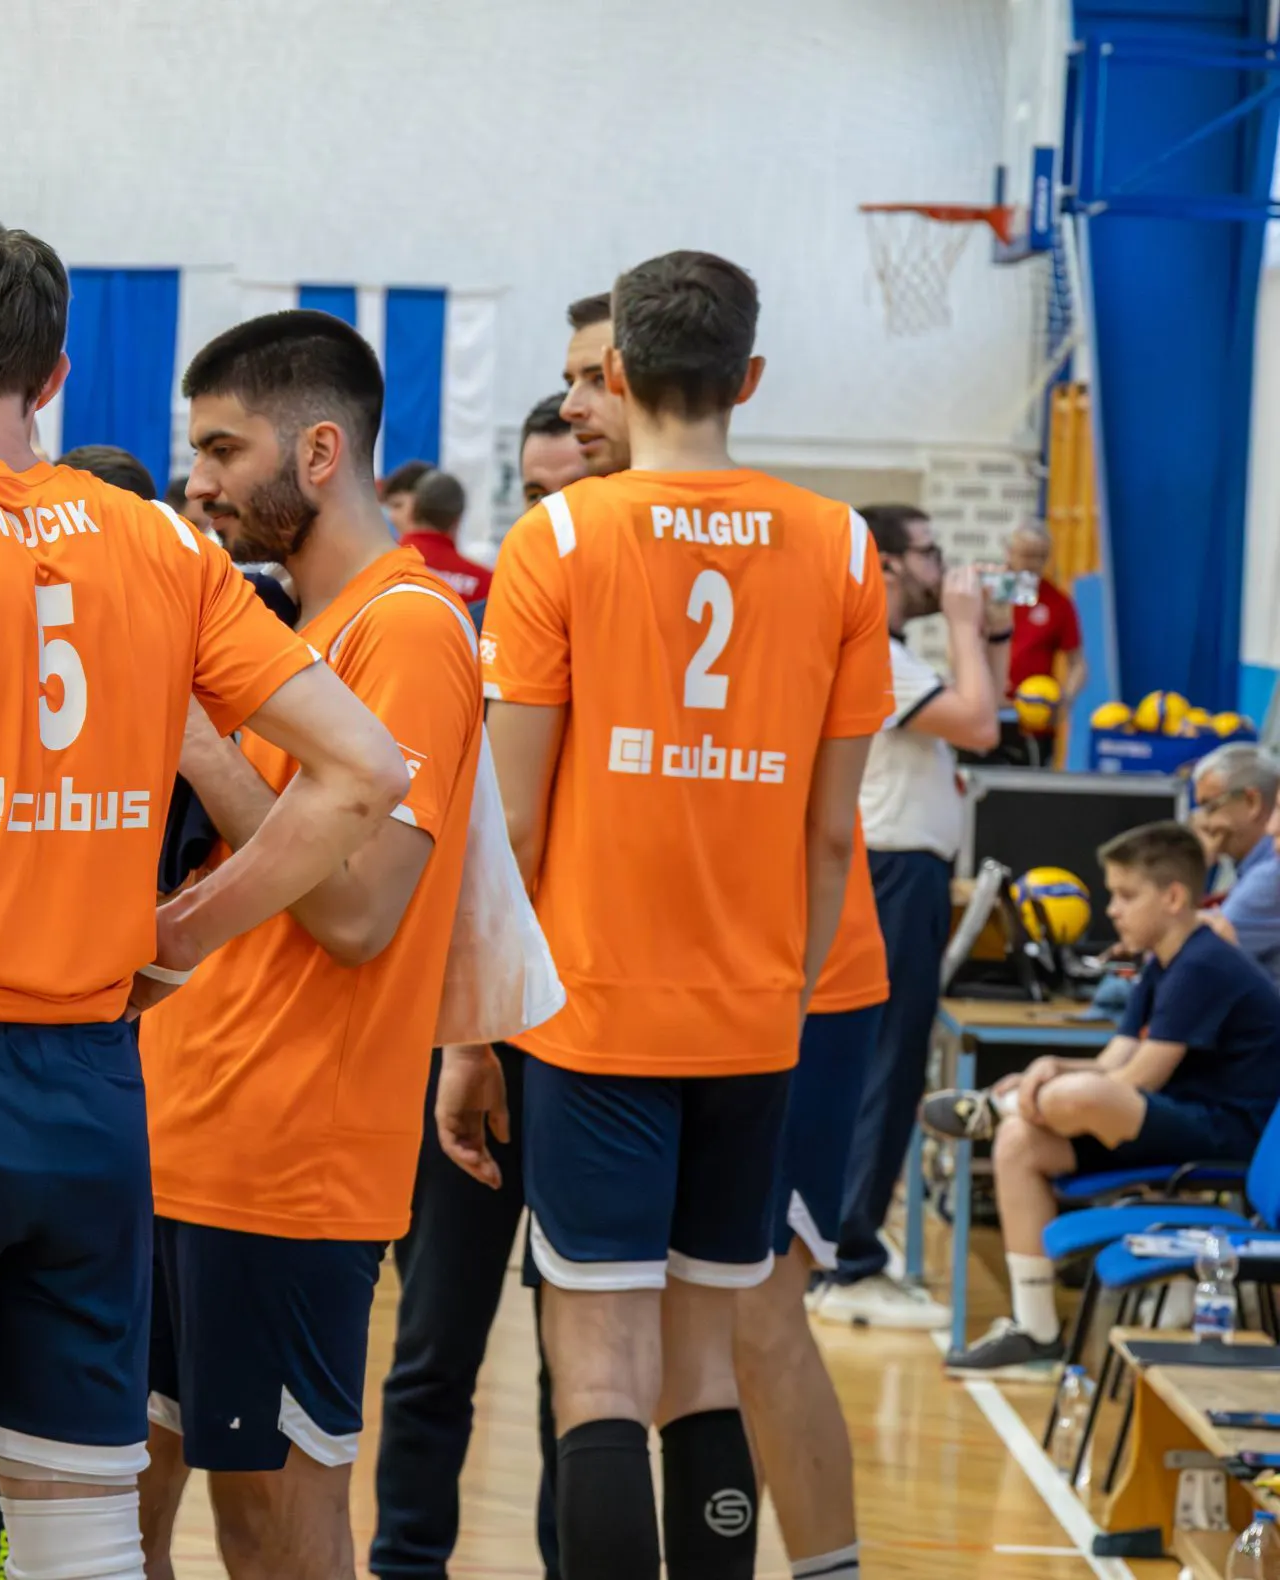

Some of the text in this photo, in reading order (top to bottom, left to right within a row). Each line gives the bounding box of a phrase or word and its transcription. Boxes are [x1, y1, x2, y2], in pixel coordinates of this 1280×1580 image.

[651, 506, 772, 546] PALGUT
[35, 582, 87, 751] 5
[684, 569, 734, 709] 2
[662, 734, 786, 783] cubus
[7, 777, 150, 832] cubus
